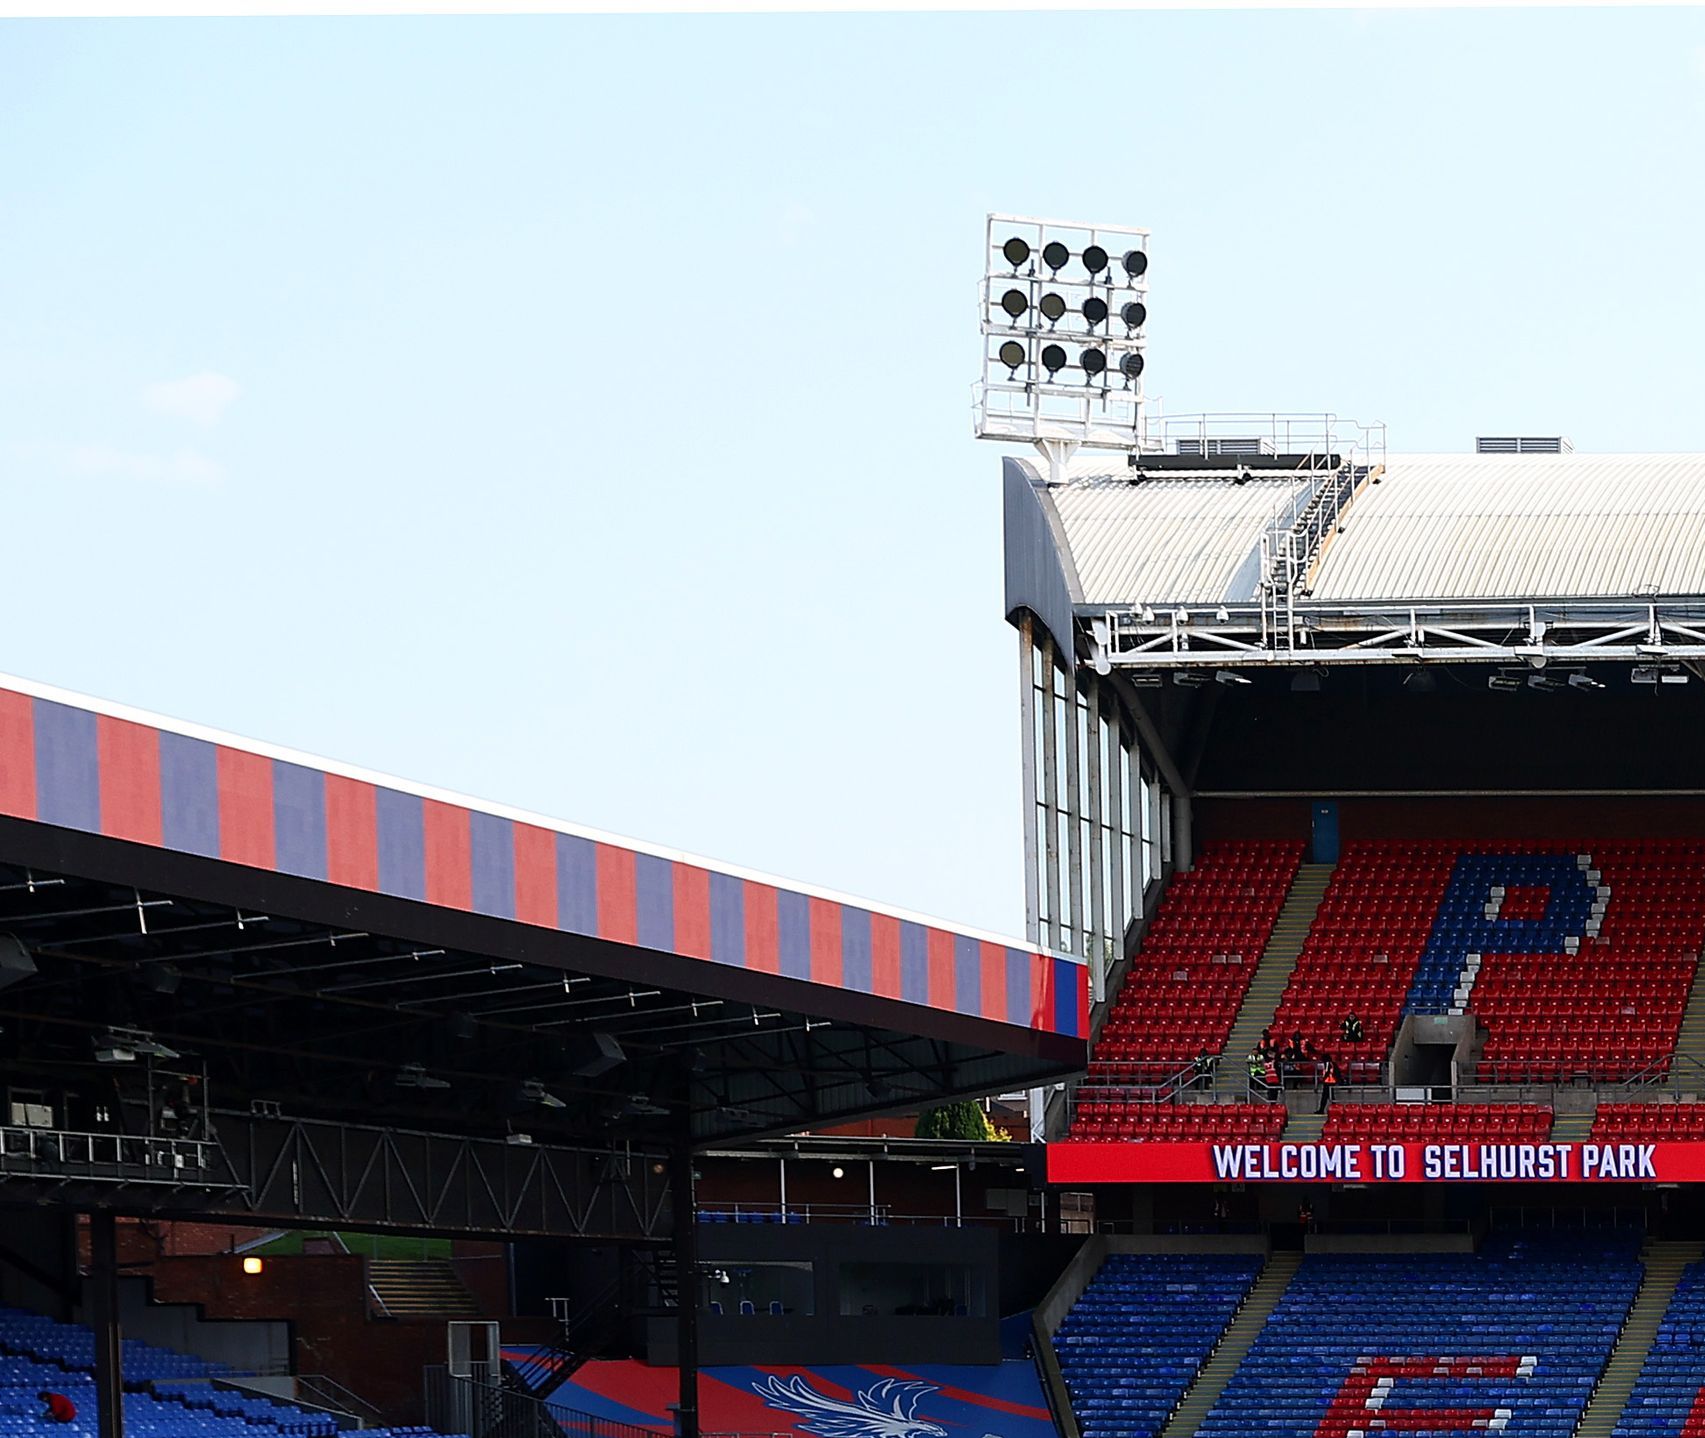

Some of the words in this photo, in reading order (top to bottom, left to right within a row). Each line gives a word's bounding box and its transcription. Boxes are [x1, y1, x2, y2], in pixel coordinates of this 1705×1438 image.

[1213, 1143, 1361, 1179] WELCOME
[1371, 1144, 1405, 1179] TO
[1425, 1144, 1573, 1179] SELHURST
[1583, 1144, 1656, 1178] PARK
